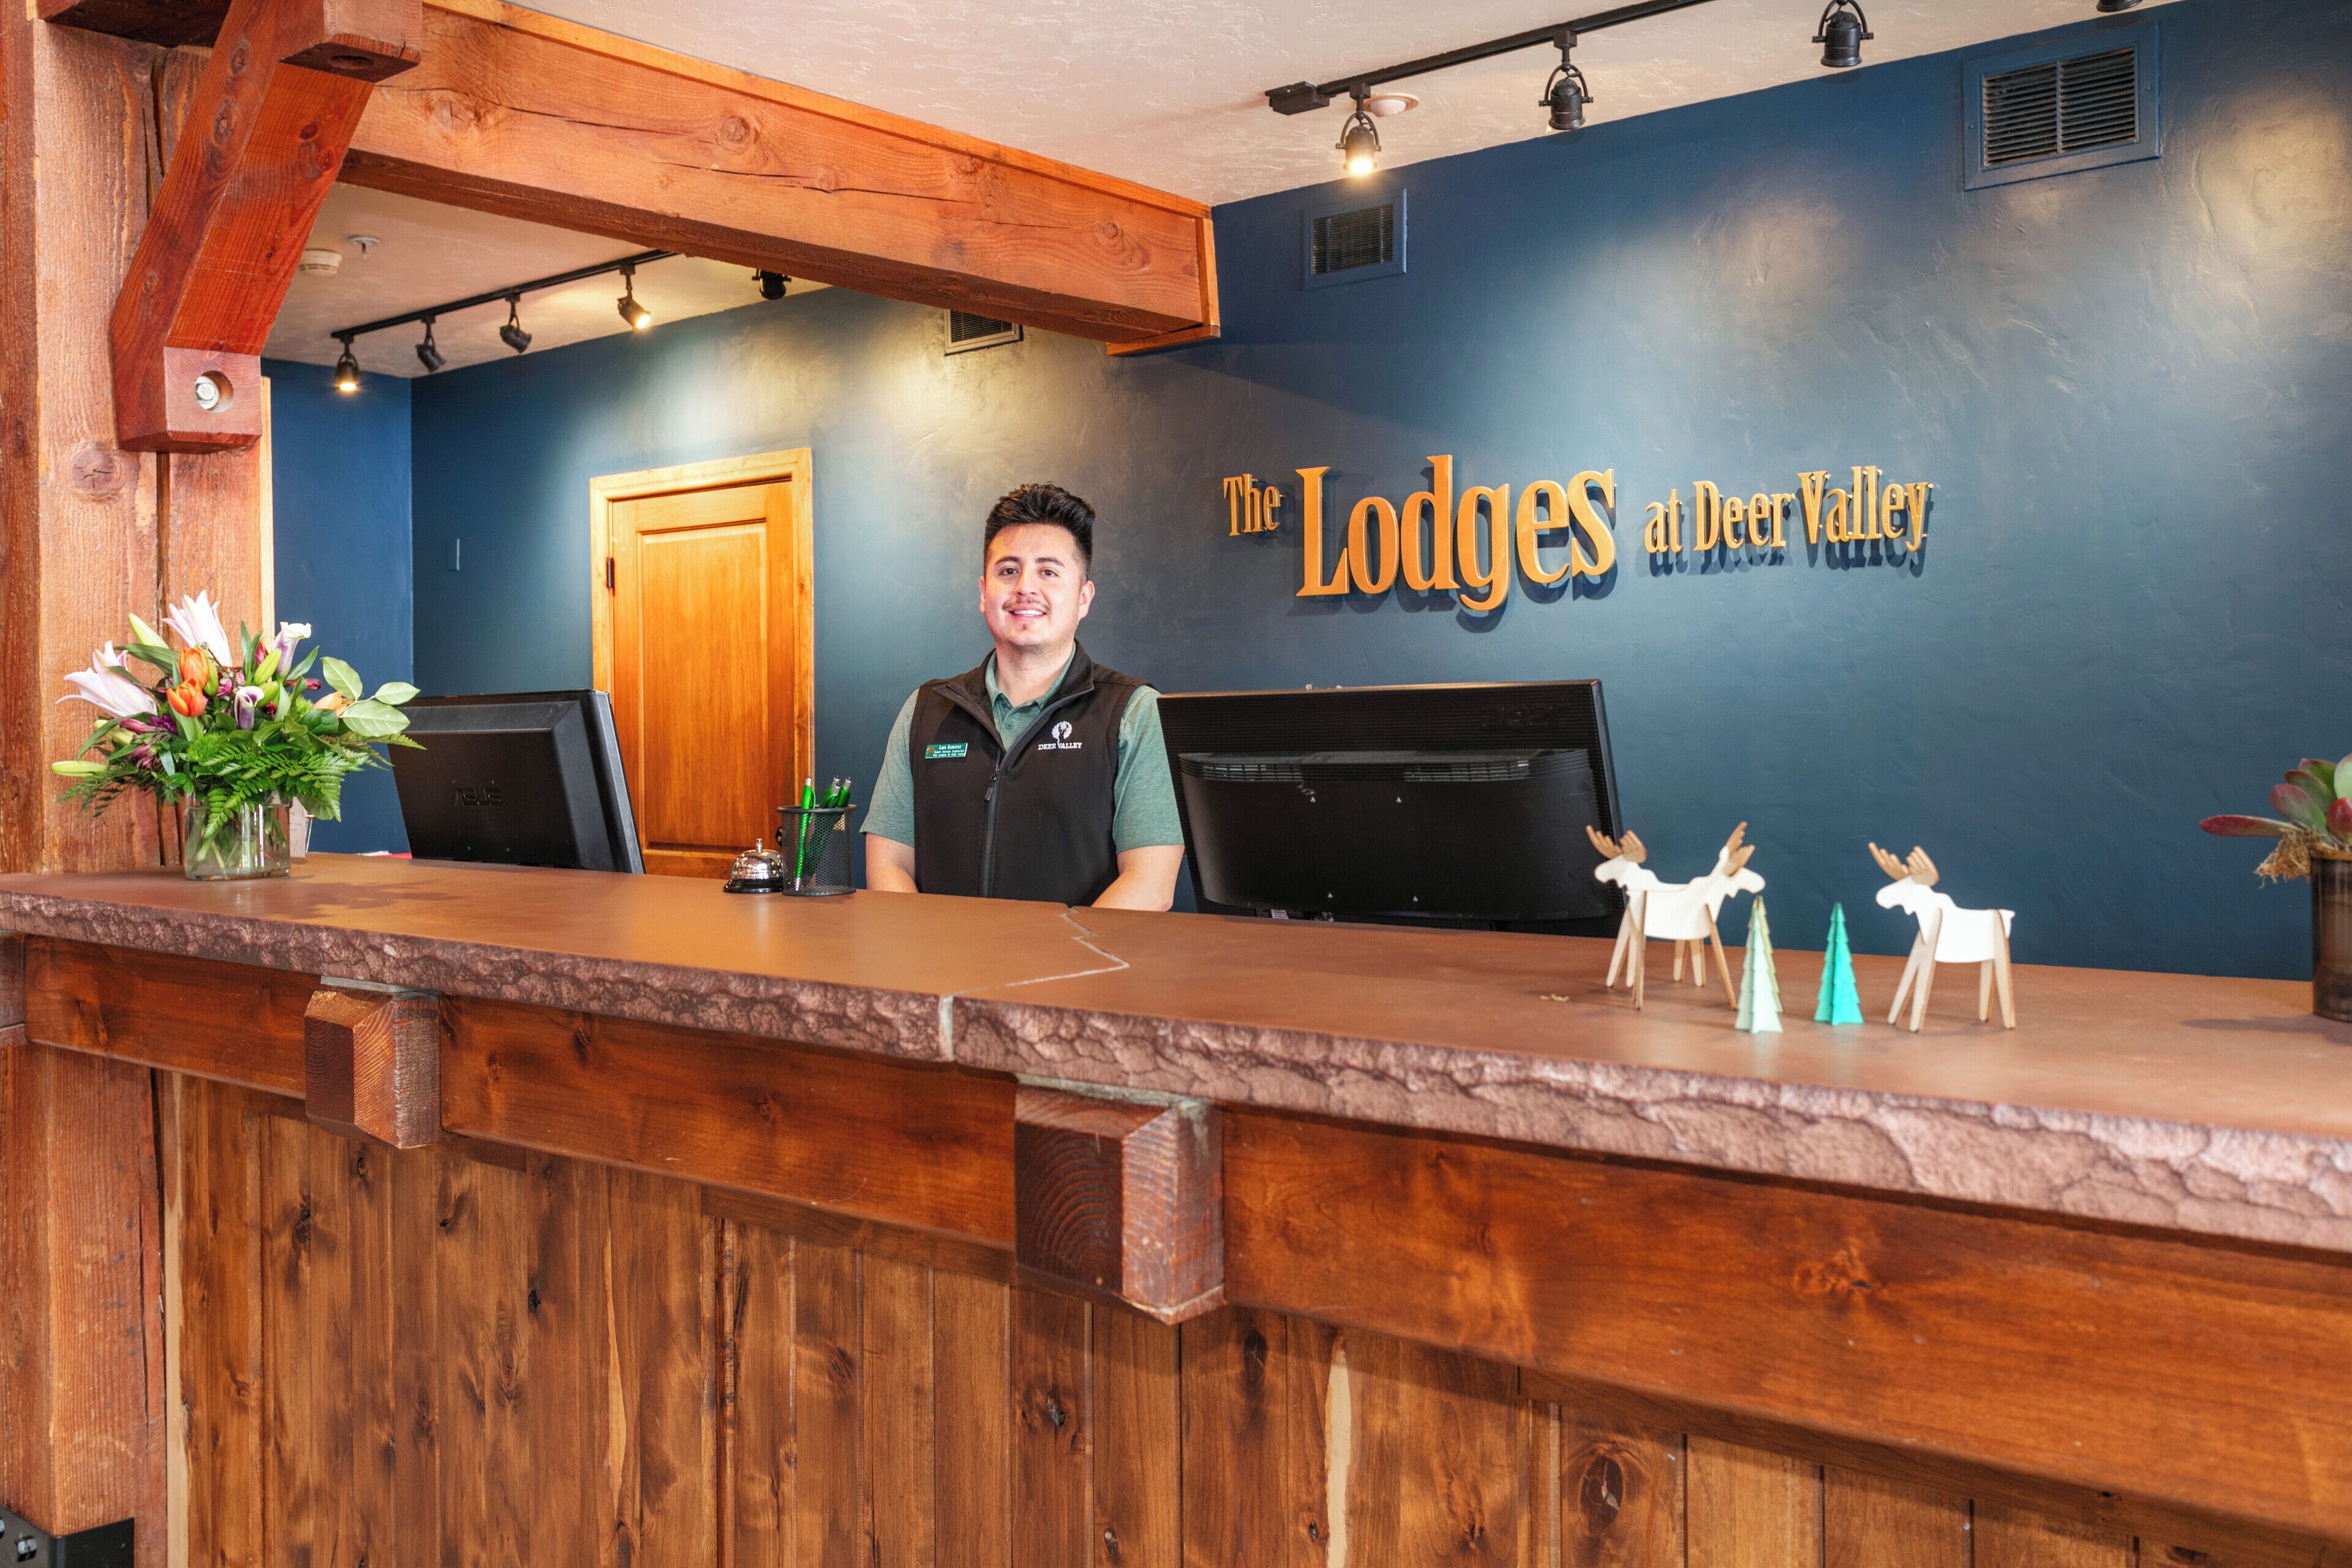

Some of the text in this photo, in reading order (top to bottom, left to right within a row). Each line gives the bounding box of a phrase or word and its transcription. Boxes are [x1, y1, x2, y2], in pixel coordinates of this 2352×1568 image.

[1223, 454, 1933, 611] The Lodges at Deer Valley
